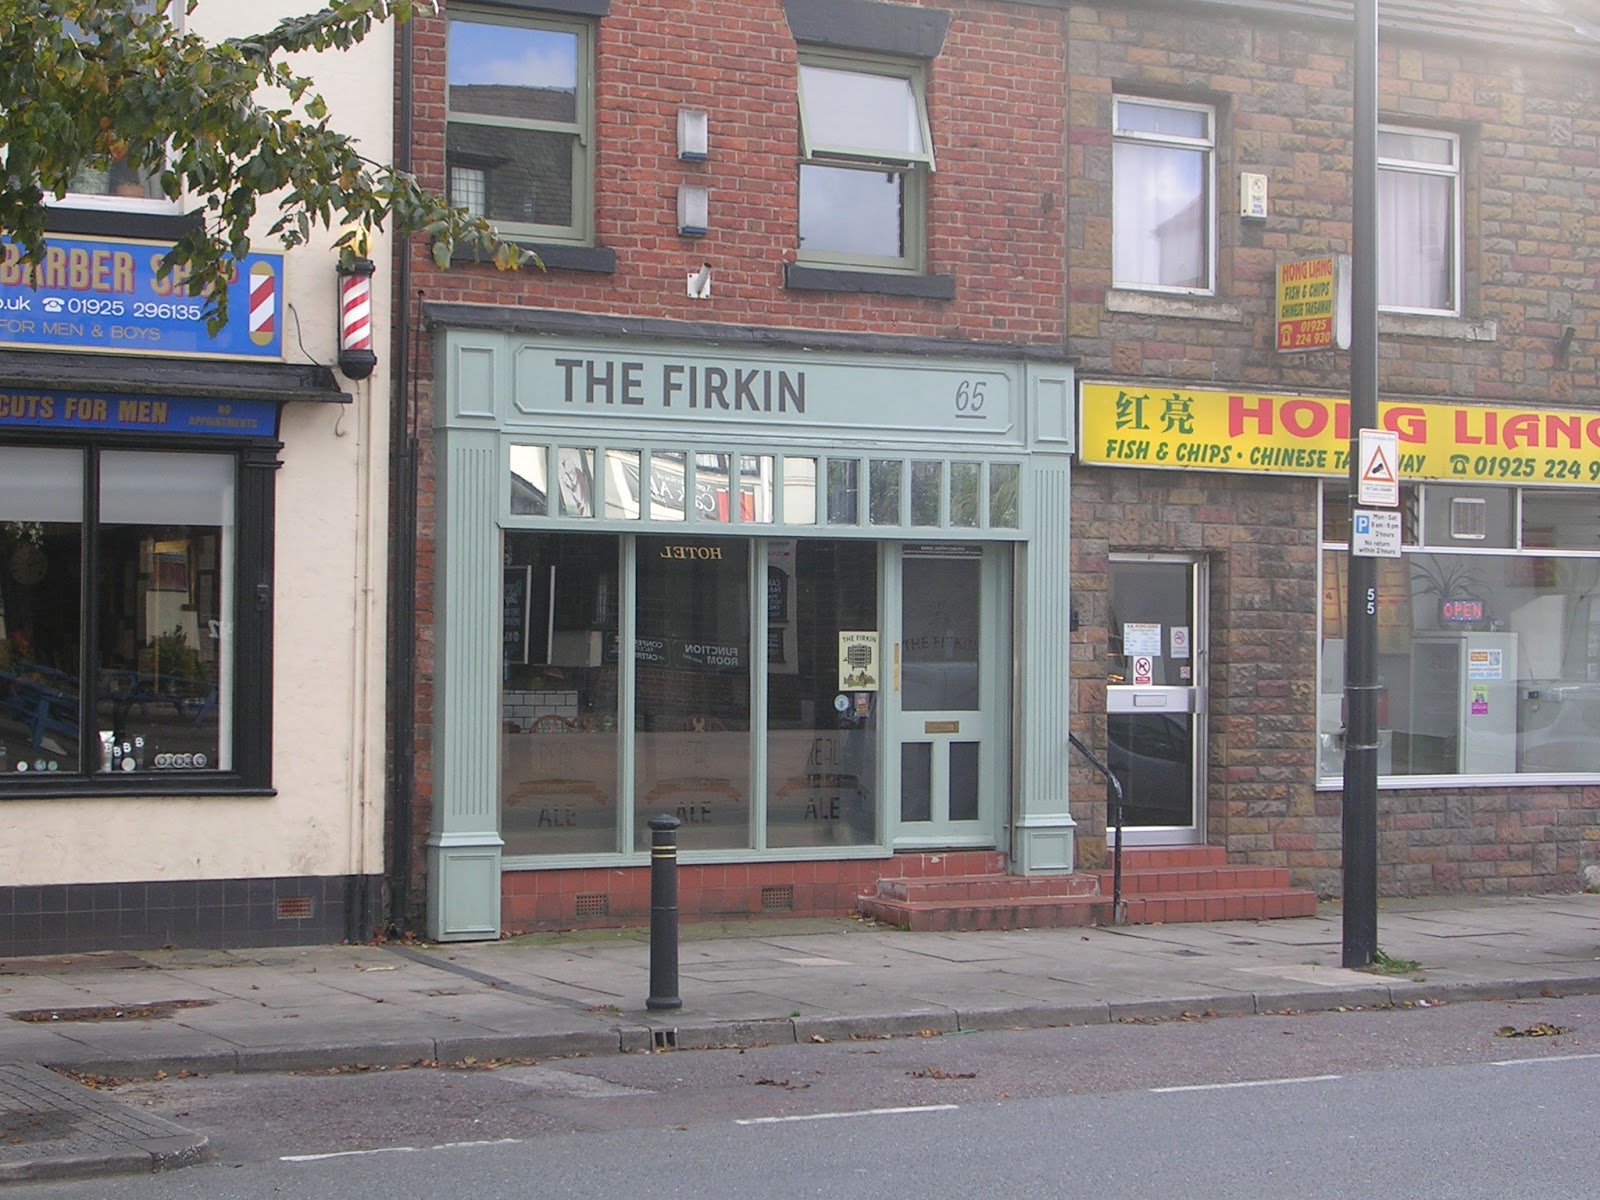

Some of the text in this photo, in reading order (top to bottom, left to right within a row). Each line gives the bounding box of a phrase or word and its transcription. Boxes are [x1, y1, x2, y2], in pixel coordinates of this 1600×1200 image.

[1282, 262, 1307, 284] HONG
[1284, 285, 1301, 301] FISH
[1309, 281, 1329, 298] CHIPS
[0, 295, 201, 320] .uk 01925 296135
[43, 321, 84, 337] MEN
[91, 324, 104, 338] &
[111, 325, 161, 340] BOYS
[1301, 319, 1326, 333] 01925
[555, 358, 805, 414] THE FIRKIN
[955, 380, 987, 412] 65
[0, 394, 168, 424] CUTS FOR MEN
[1115, 391, 1195, 435] 红亮
[1106, 439, 1150, 460] FISH
[1156, 442, 1168, 460] &
[1176, 442, 1232, 464] CHIPS
[1250, 446, 1328, 467] CHINESE
[1474, 455, 1536, 478] 01925
[1544, 459, 1581, 480] 224
[1443, 603, 1482, 618] OPEN
[843, 634, 877, 643] THE FIRKIN
[676, 801, 711, 823] ALE
[805, 797, 840, 819] ALE
